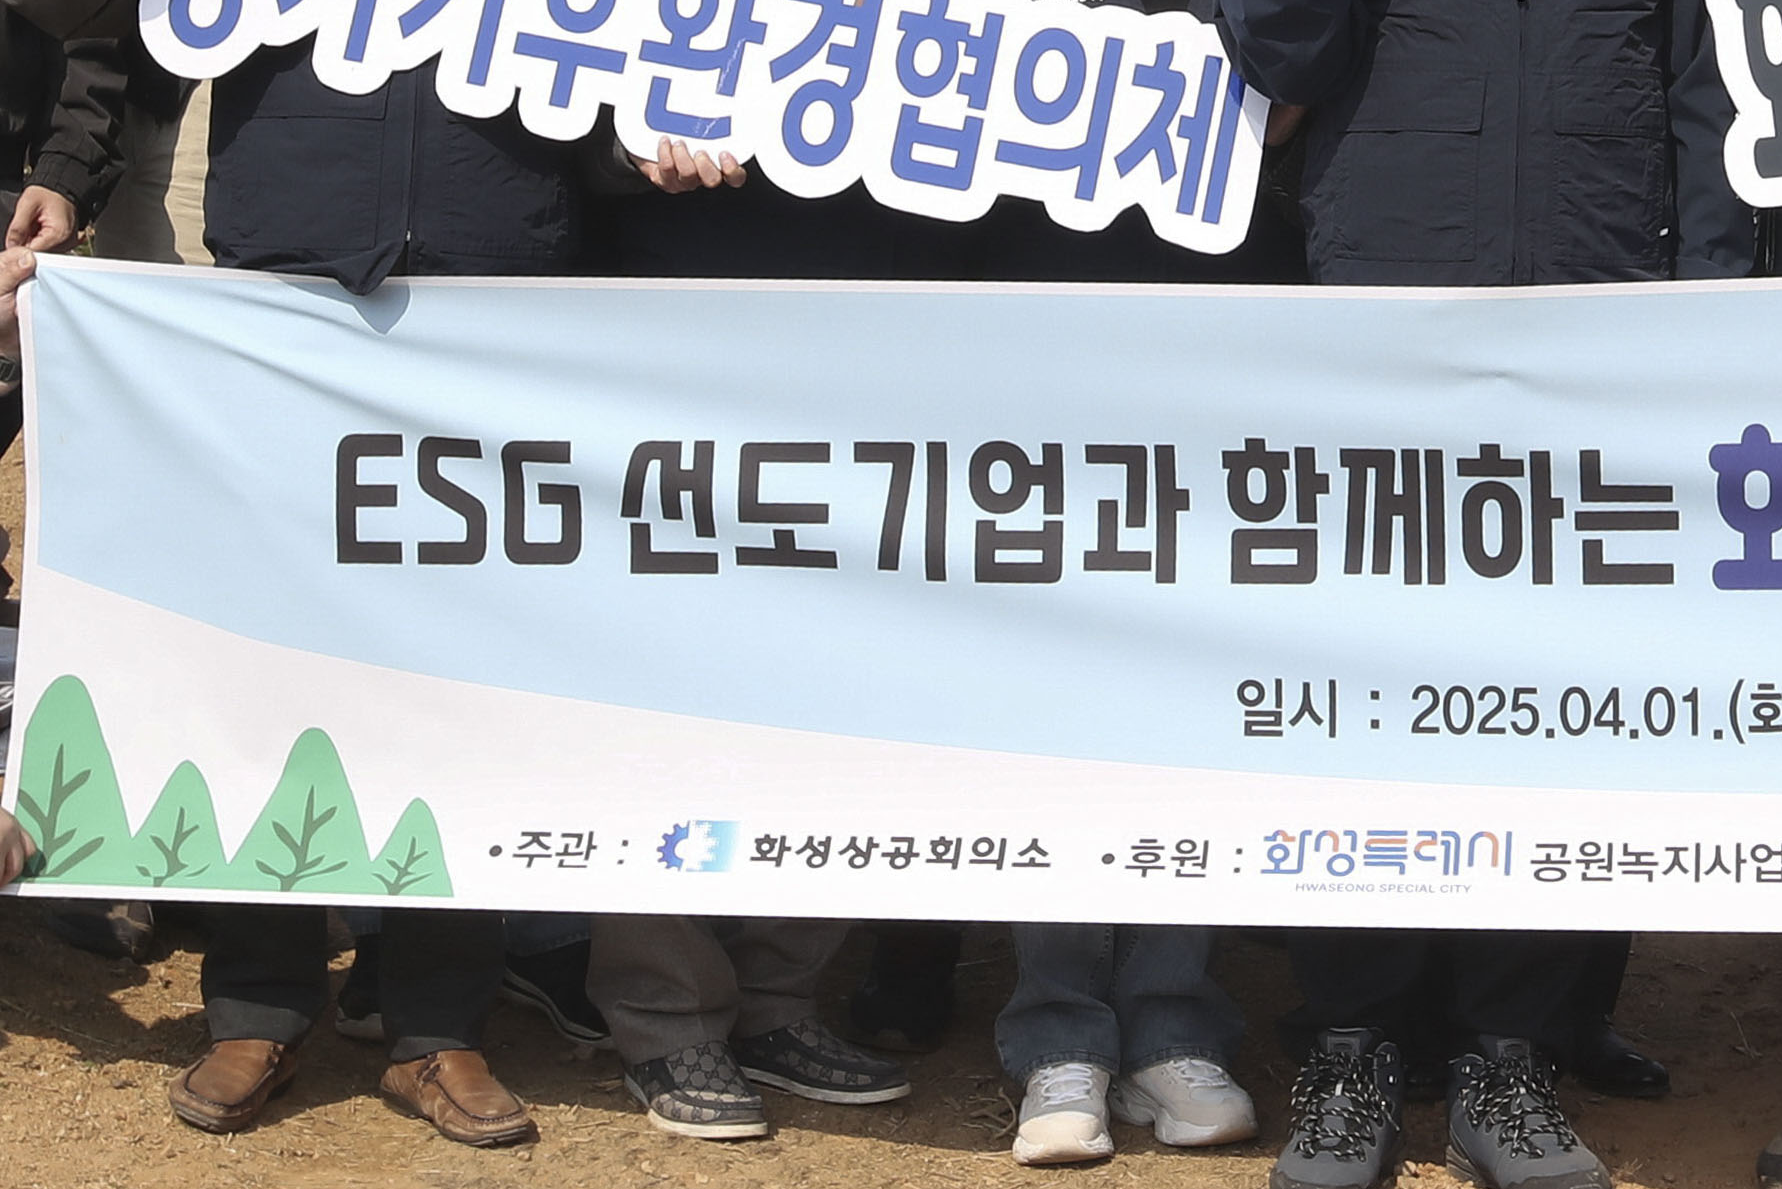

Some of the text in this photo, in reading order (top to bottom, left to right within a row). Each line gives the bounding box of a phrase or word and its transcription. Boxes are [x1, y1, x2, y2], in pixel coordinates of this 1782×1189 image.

[335, 433, 583, 566] ESG
[620, 439, 1191, 584] 선도기업과
[1220, 437, 1681, 587] 함께하는
[1236, 678, 1338, 739] 일시
[749, 833, 1053, 871] 화성상공회의소
[1260, 829, 1514, 877] 화성특례시
[1295, 882, 1472, 895] HWASEONG SPECIAL CITY
